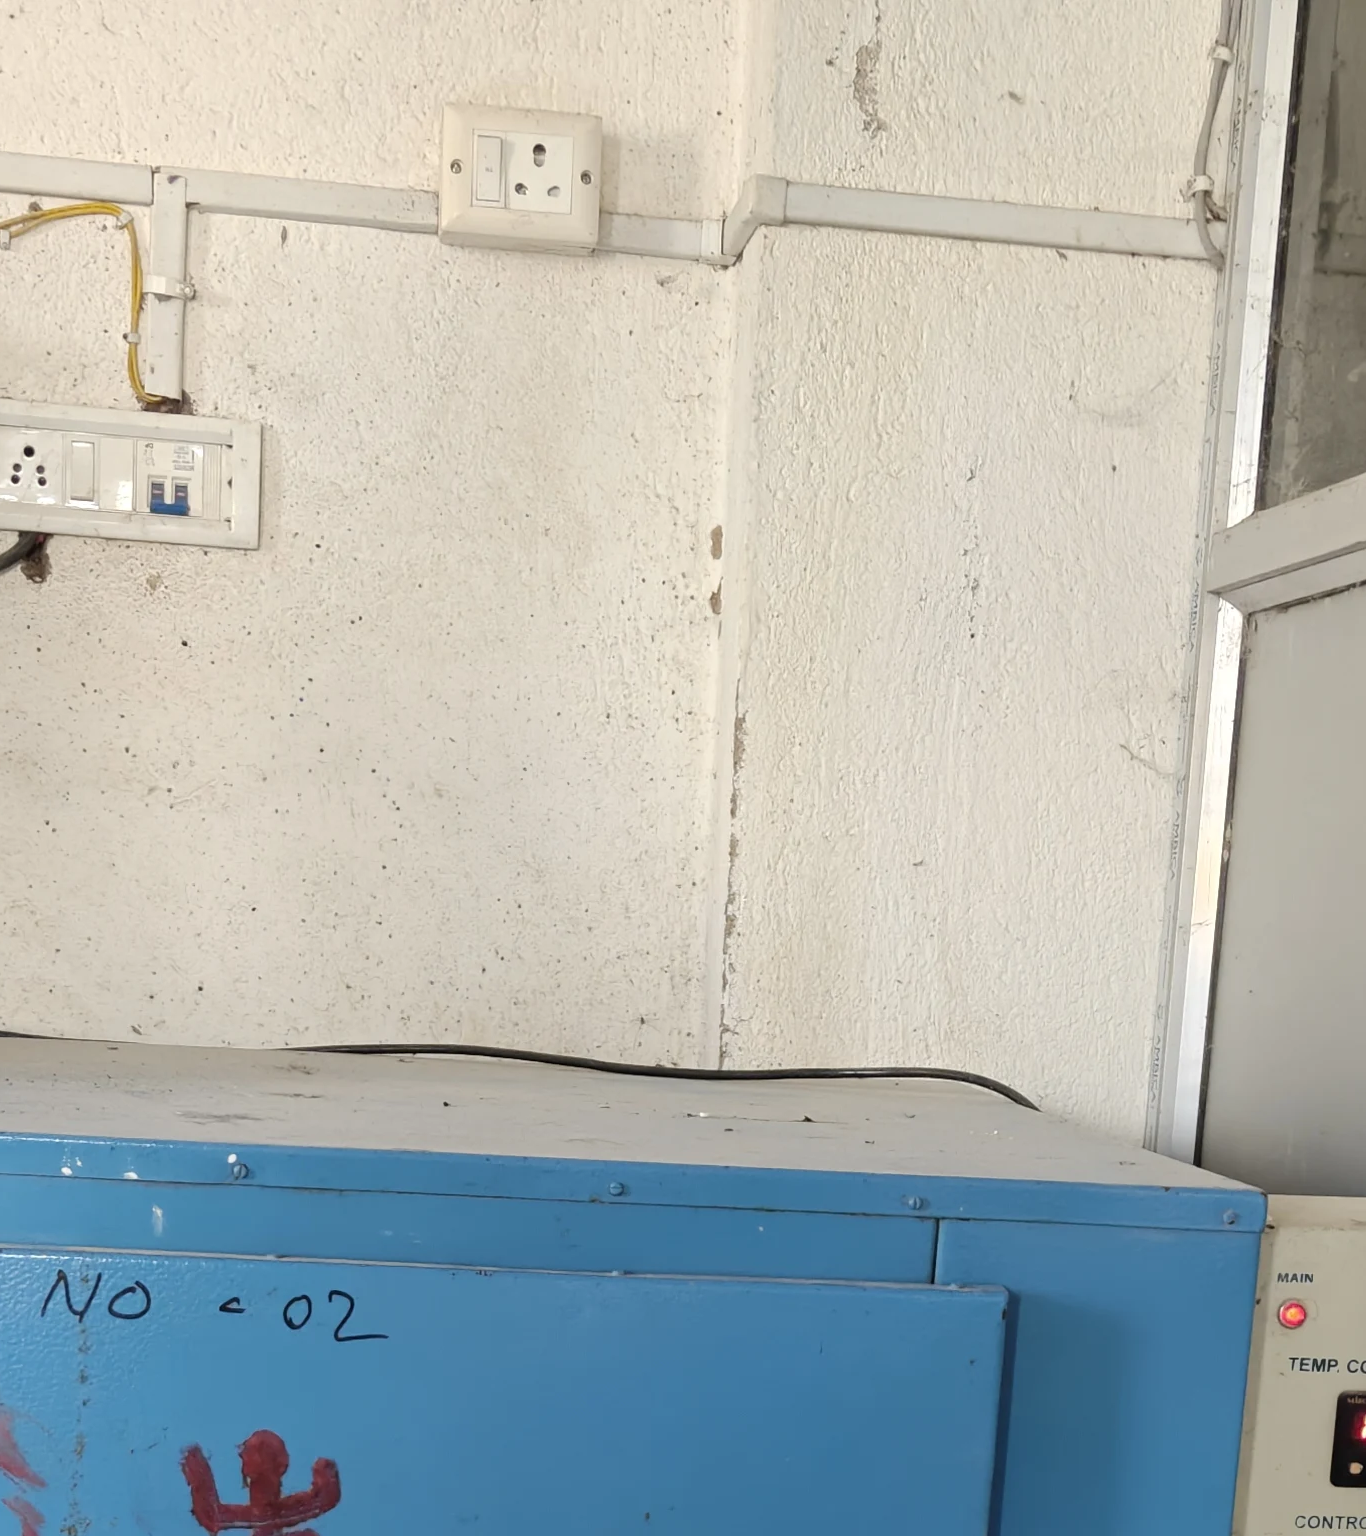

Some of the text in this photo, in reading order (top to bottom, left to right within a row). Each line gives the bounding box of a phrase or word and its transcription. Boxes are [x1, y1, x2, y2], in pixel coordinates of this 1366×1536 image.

[1277, 1272, 1314, 1284] MAIN
[41, 1268, 152, 1322] NO
[281, 1289, 390, 1343] 02
